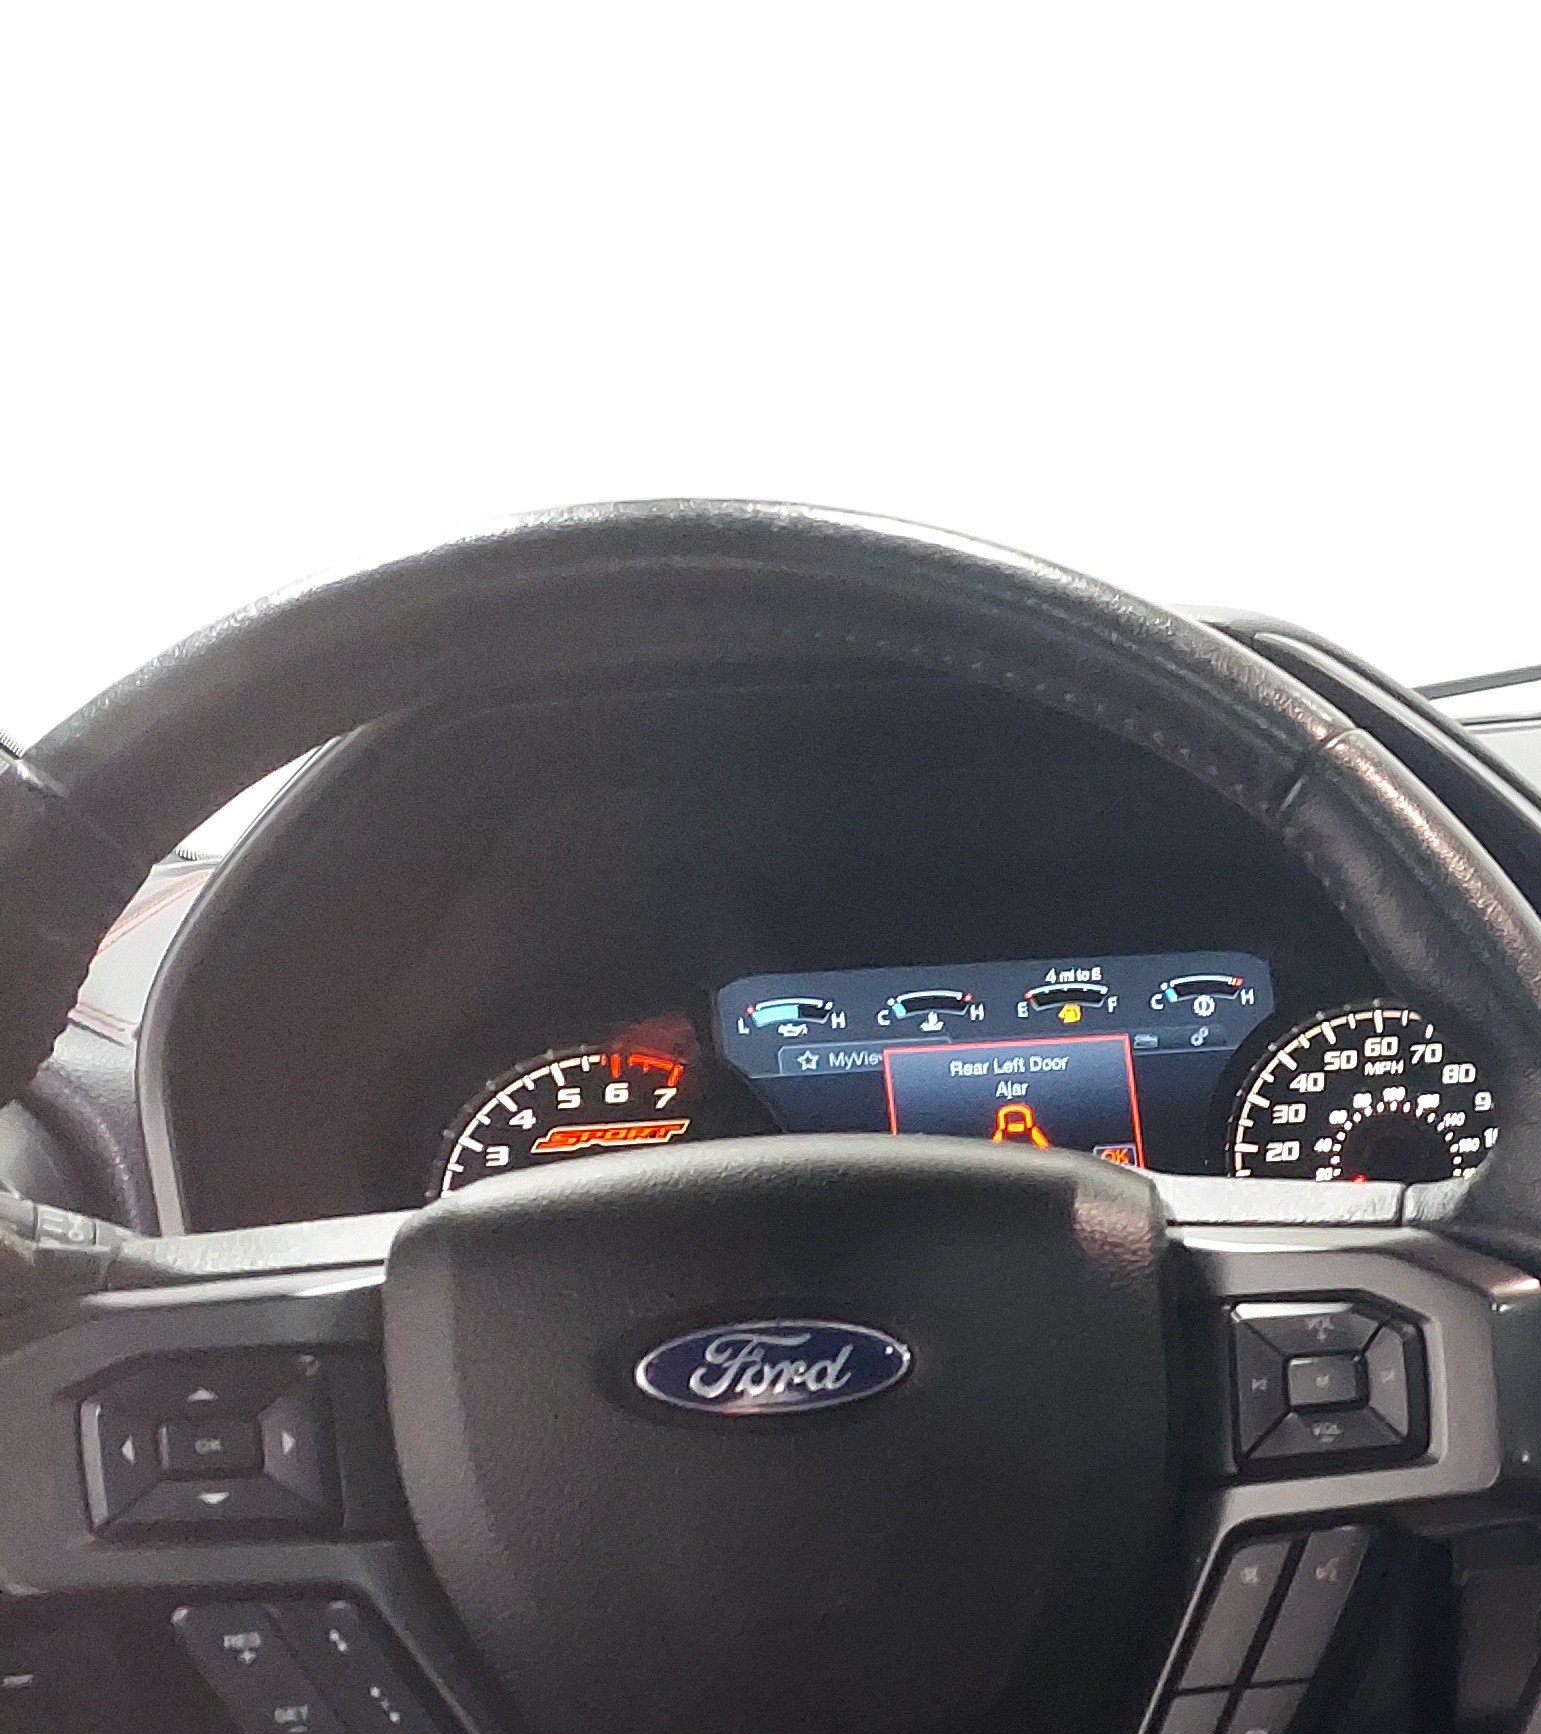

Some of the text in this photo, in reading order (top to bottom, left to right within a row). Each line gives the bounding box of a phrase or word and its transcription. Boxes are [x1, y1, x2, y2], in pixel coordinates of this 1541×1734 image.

[1045, 968, 1057, 983] 4
[1076, 967, 1090, 981] to
[1107, 996, 1118, 1013] F
[1150, 994, 1164, 1010] C
[1240, 988, 1255, 1005] H
[831, 1010, 846, 1029] H
[877, 1009, 891, 1026] C
[970, 1003, 985, 1021] H
[1017, 1001, 1028, 1018] E
[737, 1017, 750, 1034] L
[1364, 1036, 1398, 1057] 60
[1409, 1043, 1443, 1064] 70
[950, 1055, 1069, 1078] Rear Left Door
[1323, 1049, 1358, 1071] 50
[1364, 1059, 1404, 1076] MPH
[1289, 1072, 1325, 1093] 40
[1441, 1063, 1476, 1084] 80
[557, 1087, 581, 1109] 5
[604, 1082, 629, 1103] 6
[654, 1087, 678, 1109] 7
[995, 1079, 1029, 1100] Ajar
[1474, 1091, 1494, 1111] 9
[509, 1109, 537, 1130] 4
[1272, 1103, 1306, 1124] 30
[537, 1122, 684, 1149] SPORT
[485, 1145, 510, 1167] 3
[1265, 1141, 1300, 1162] 20
[689, 1333, 853, 1398] Ford
